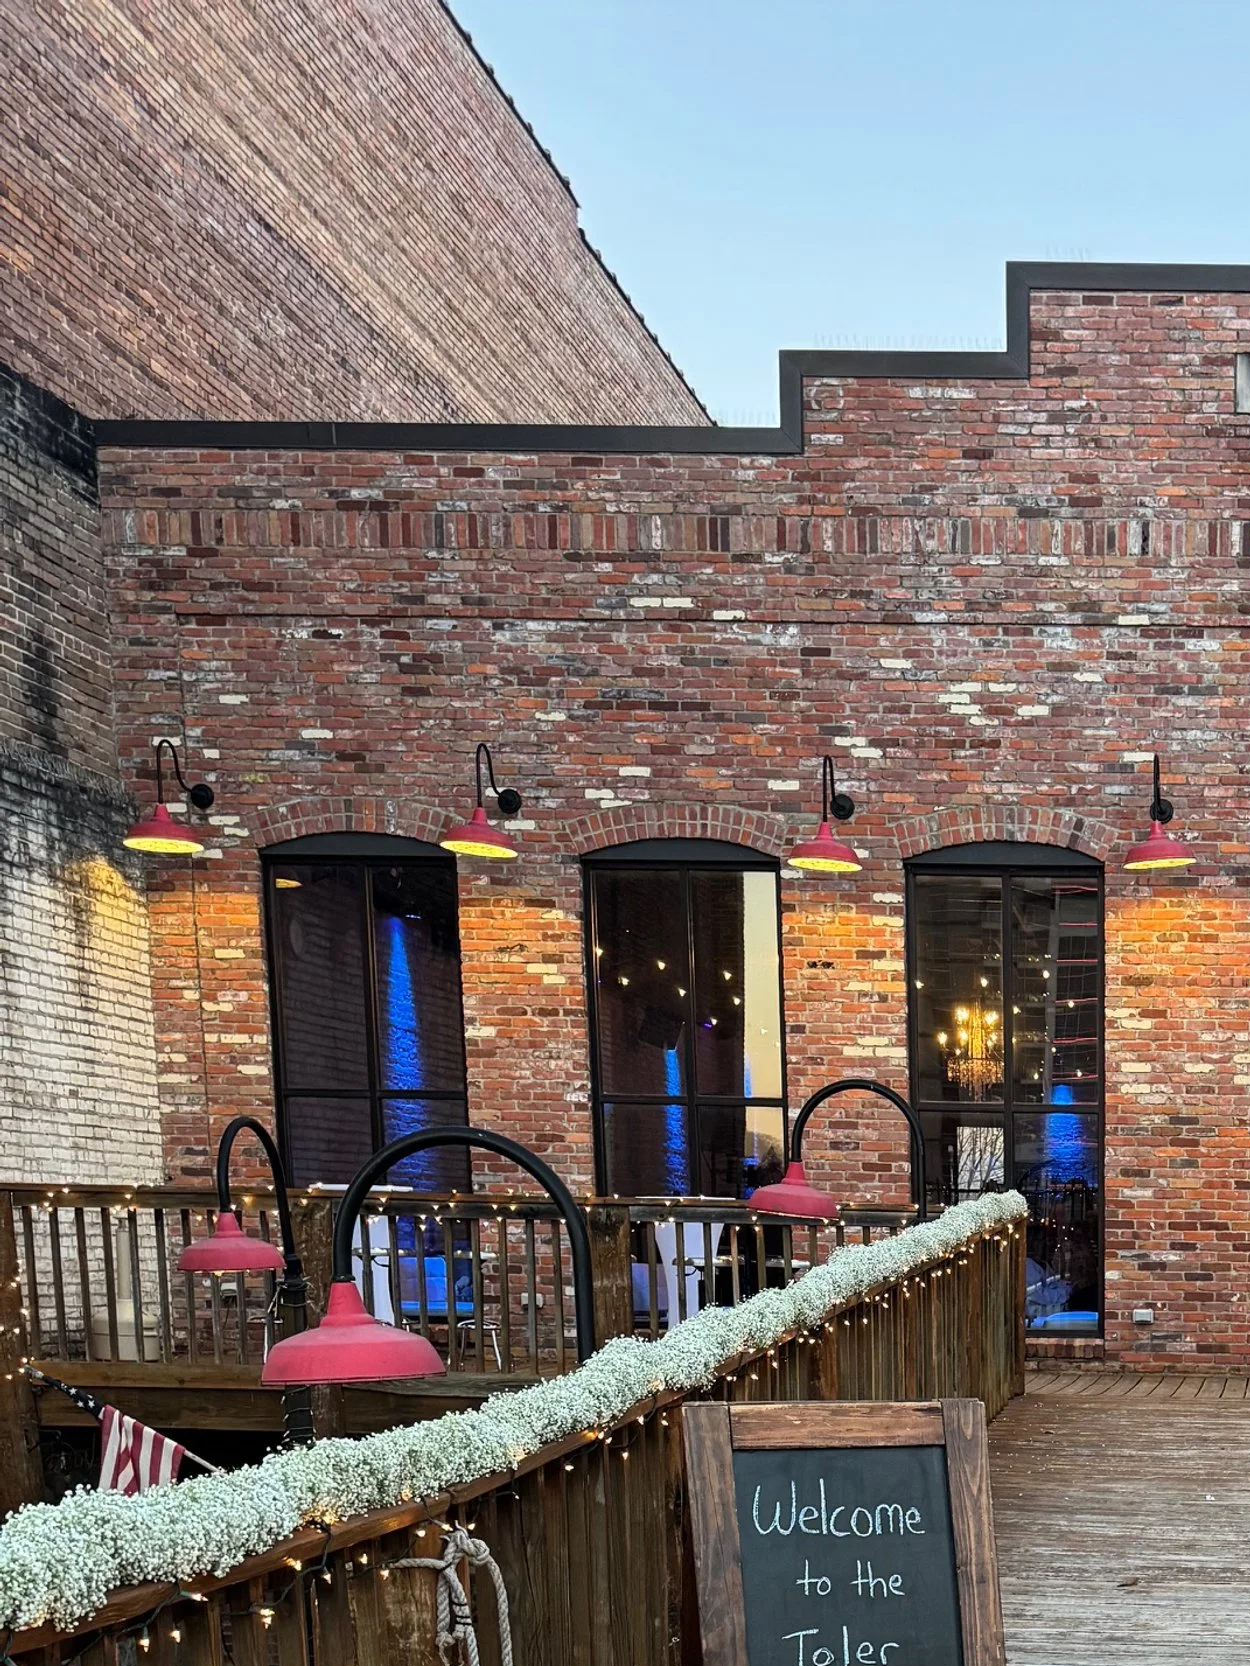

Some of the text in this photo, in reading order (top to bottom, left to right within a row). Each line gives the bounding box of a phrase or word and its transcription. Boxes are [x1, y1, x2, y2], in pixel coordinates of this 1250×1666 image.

[752, 1478, 926, 1537] Welcome
[795, 1559, 905, 1598] to the
